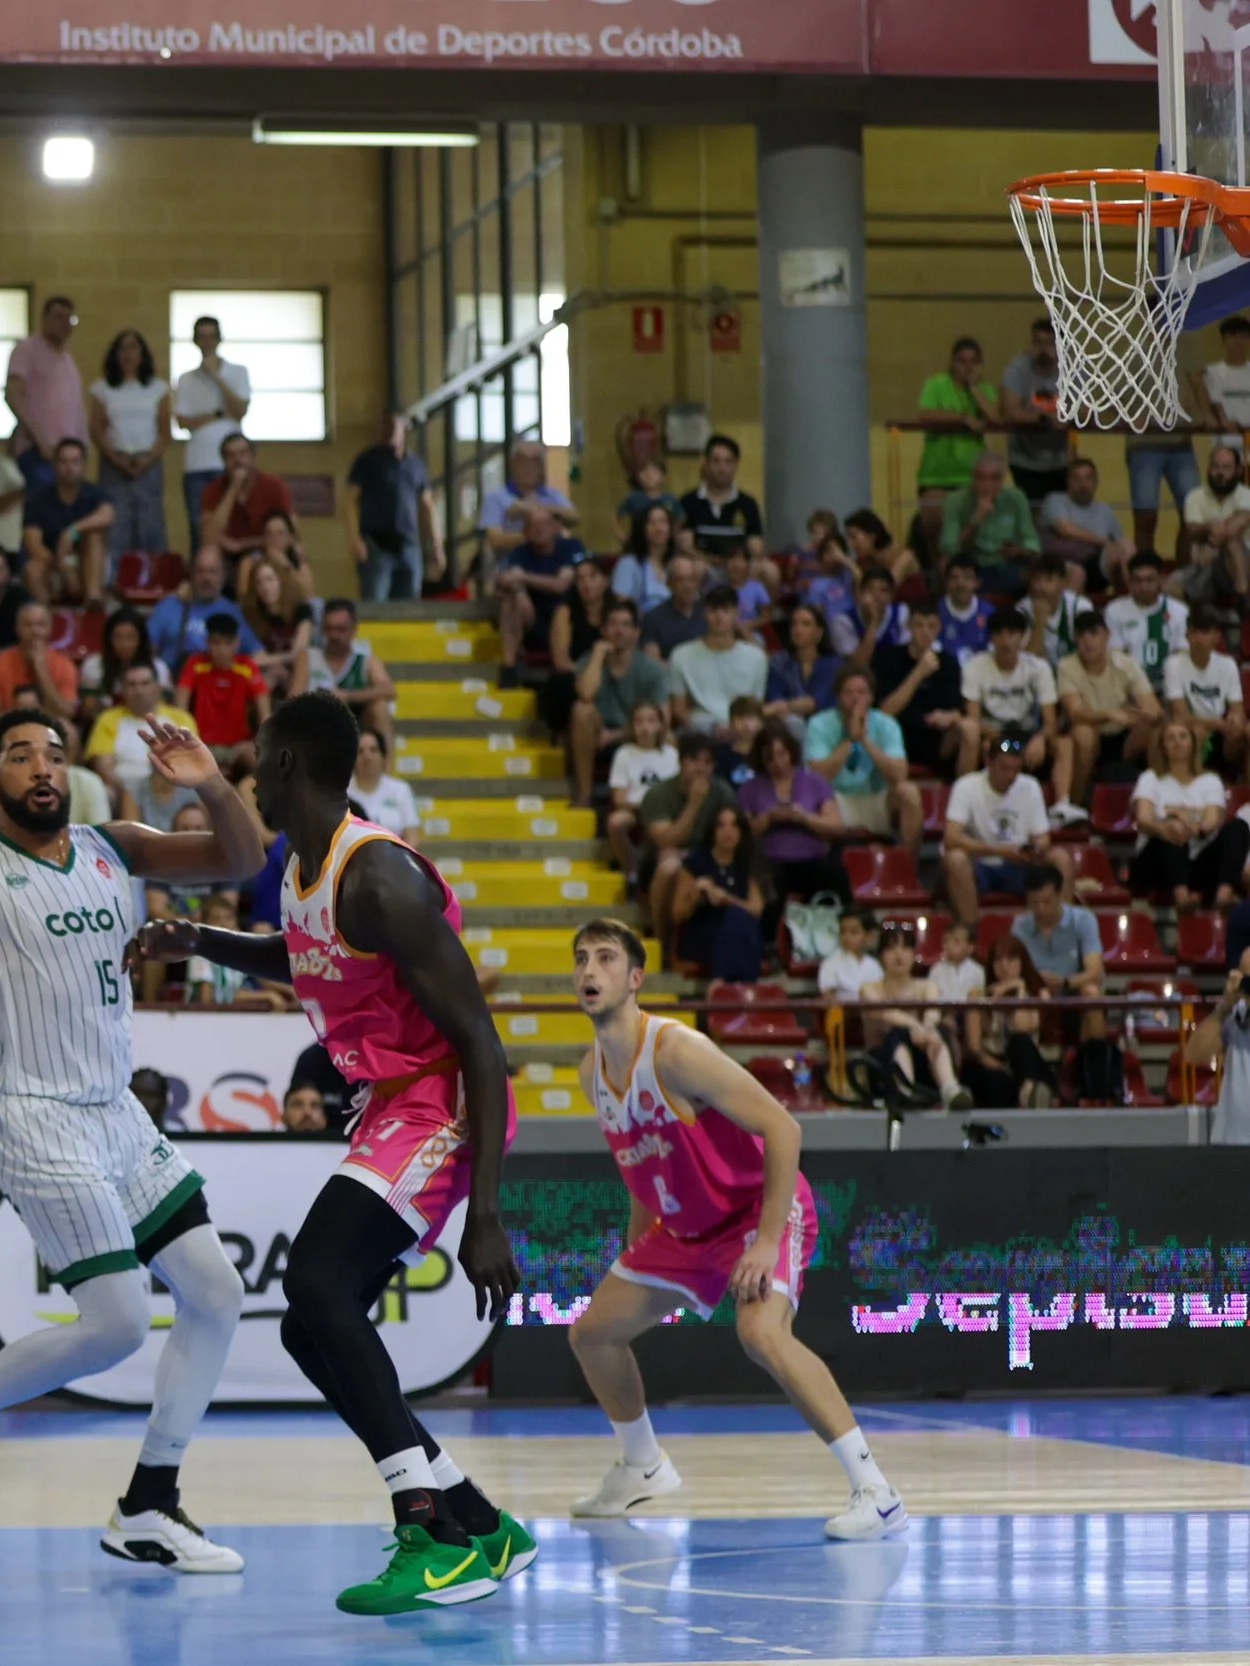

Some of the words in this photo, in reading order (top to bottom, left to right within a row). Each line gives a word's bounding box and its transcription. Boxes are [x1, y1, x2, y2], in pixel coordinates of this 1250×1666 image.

[60, 19, 200, 51] Instituto
[208, 21, 375, 61] Municipal
[384, 24, 428, 55] de
[438, 24, 592, 62] Deportes
[599, 25, 744, 58] Córdoba
[45, 906, 115, 937] coto
[94, 959, 119, 1006] 15
